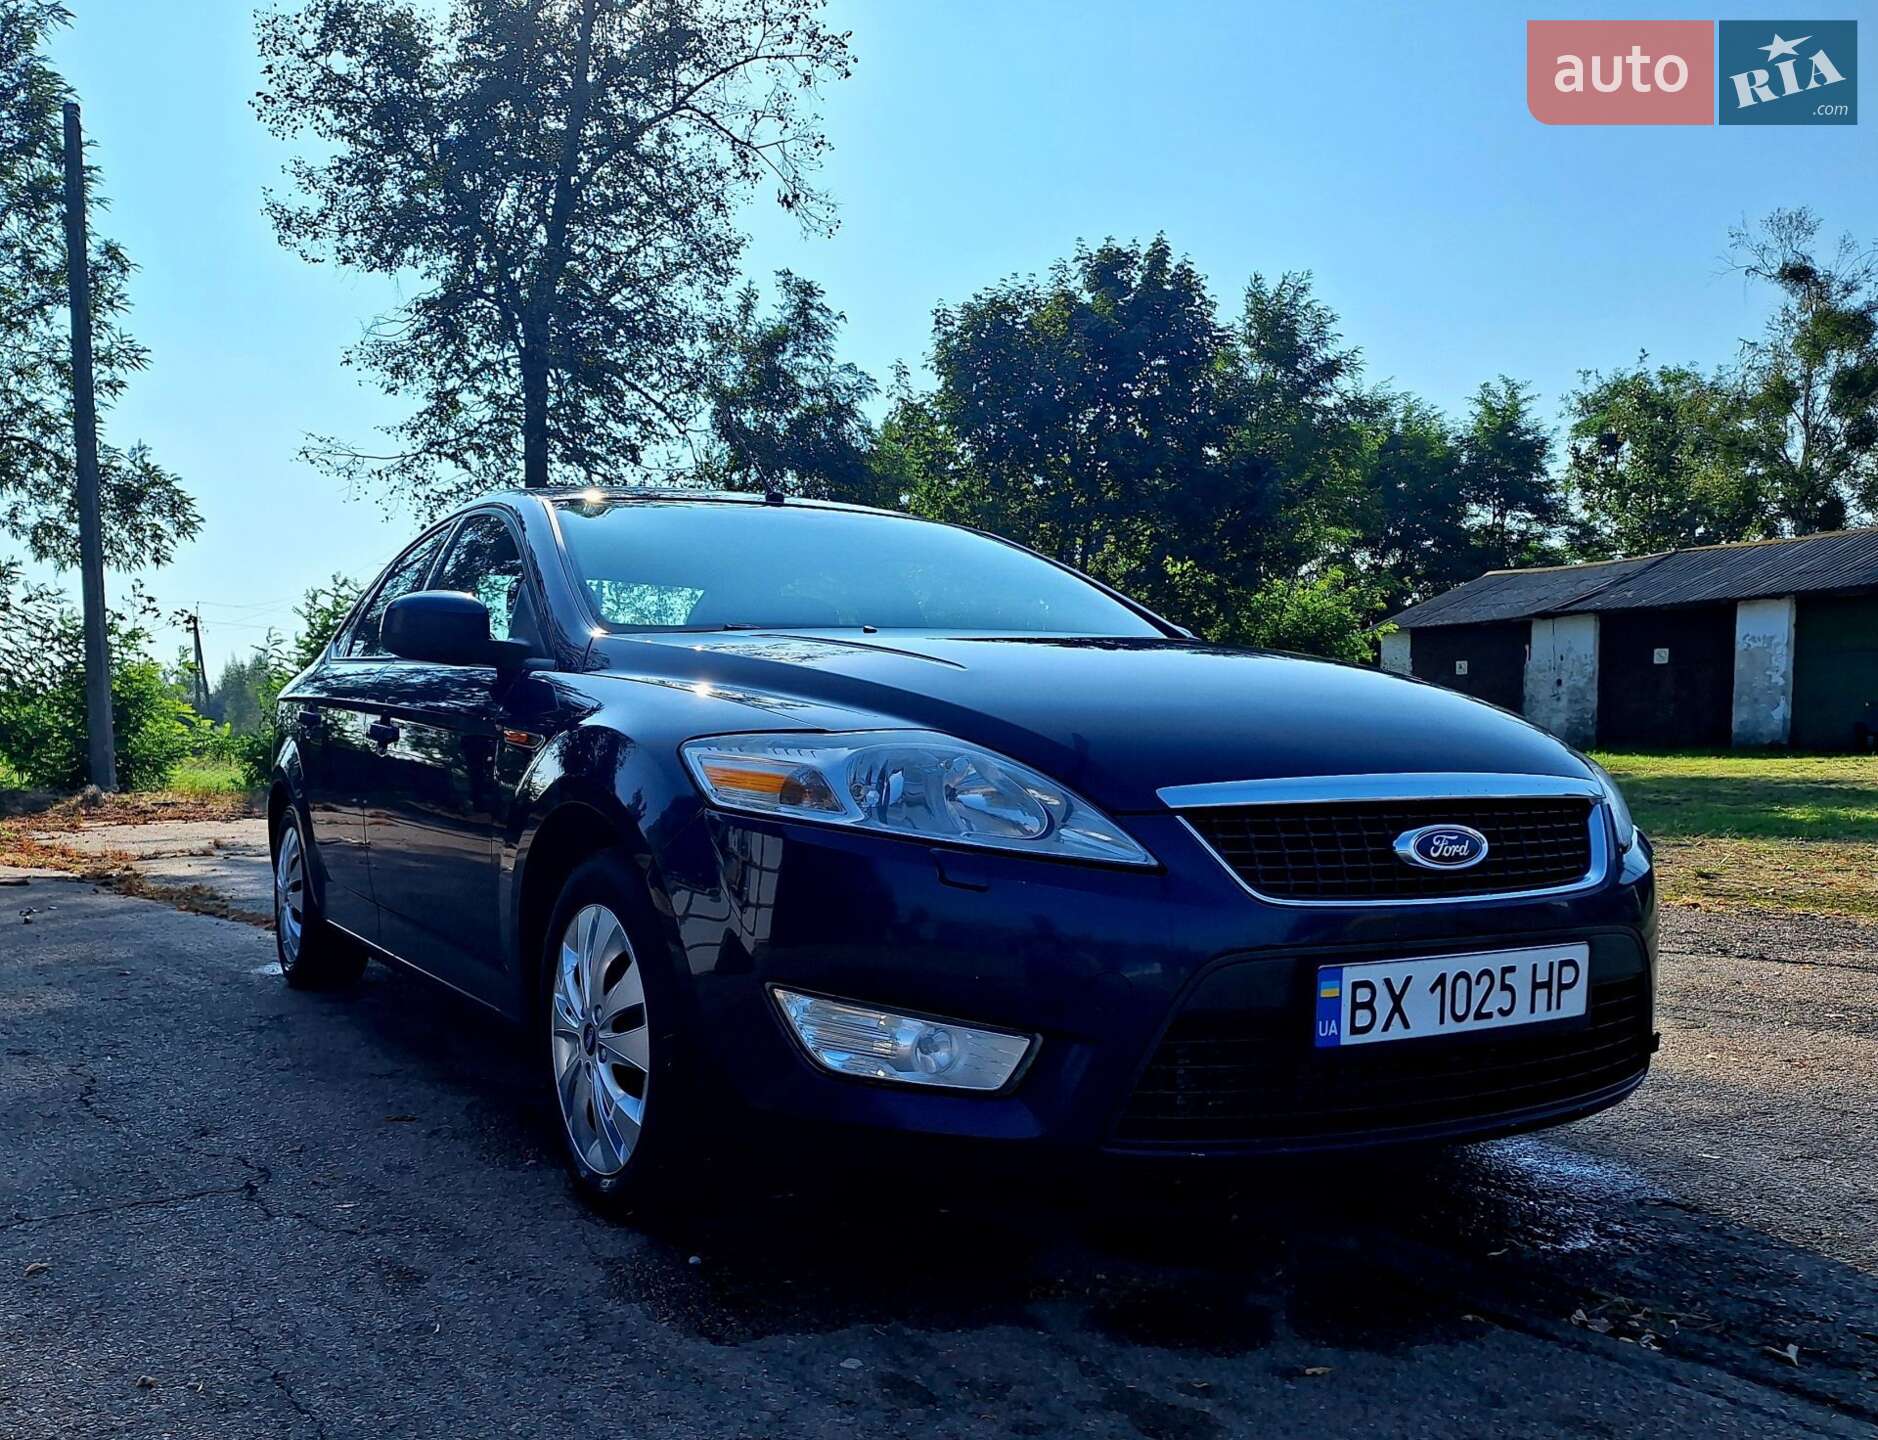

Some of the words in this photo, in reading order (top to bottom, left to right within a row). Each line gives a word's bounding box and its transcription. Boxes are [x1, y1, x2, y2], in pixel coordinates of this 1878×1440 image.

[1430, 834, 1470, 858] Ford
[1349, 975, 1413, 1036] BX
[1429, 965, 1517, 1026] 1025
[1529, 958, 1580, 1015] HP
[1319, 1020, 1338, 1037] UA
